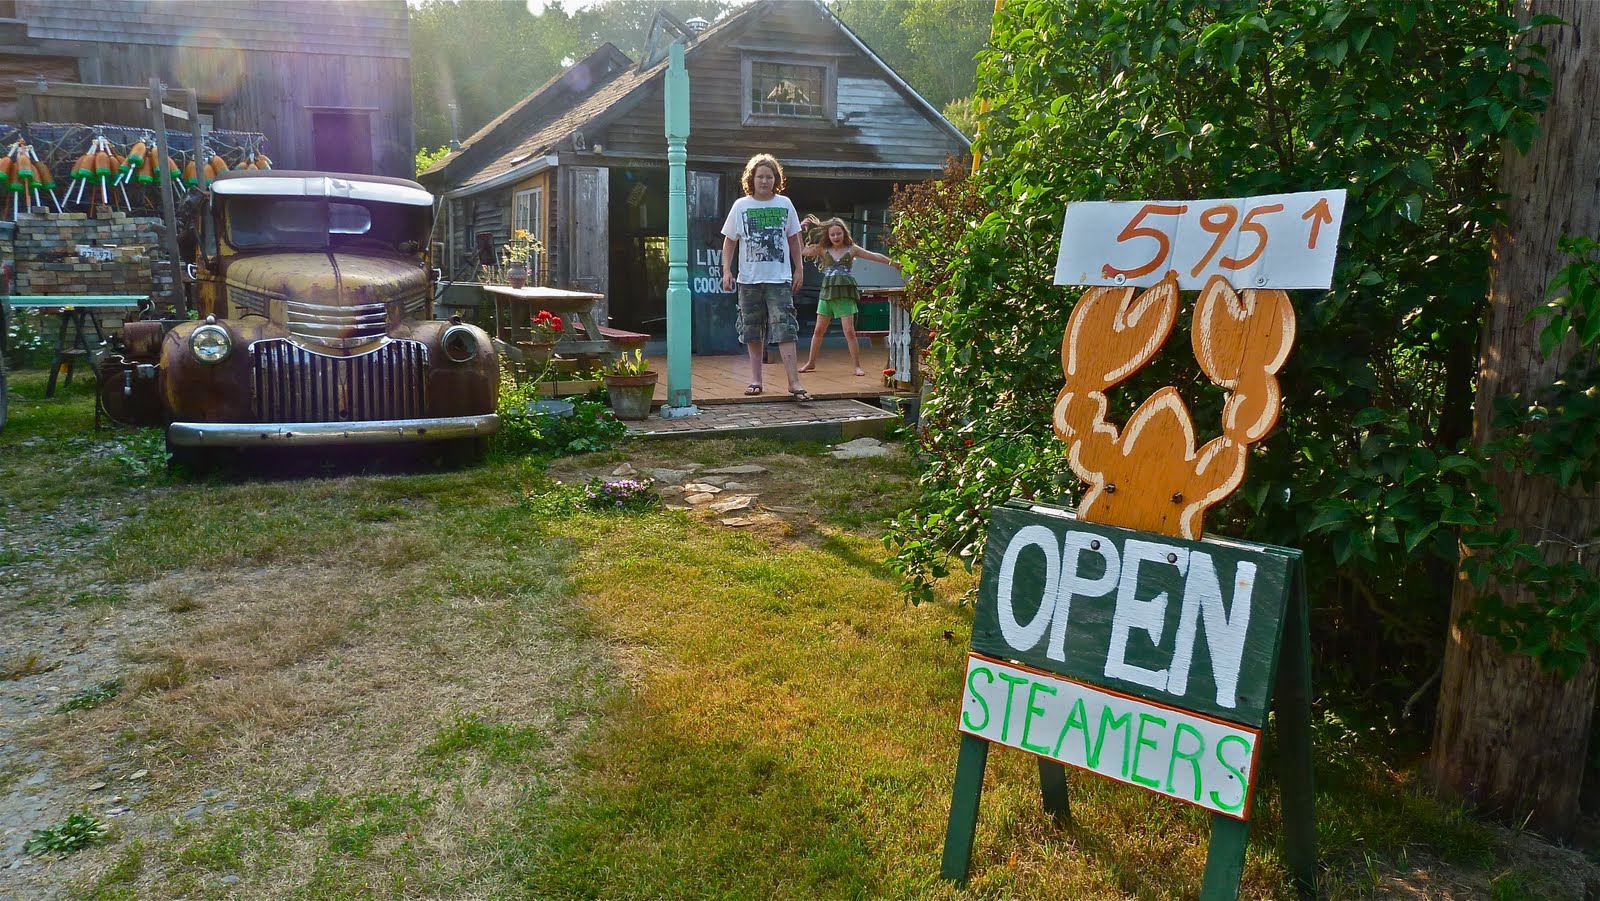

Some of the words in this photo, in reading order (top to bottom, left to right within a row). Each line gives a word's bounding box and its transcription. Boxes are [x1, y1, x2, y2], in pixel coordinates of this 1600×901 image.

[693, 277, 737, 294] COOKD
[708, 266, 721, 277] OR
[997, 525, 1257, 708] OPEN
[962, 666, 1251, 811] STEAMERS
